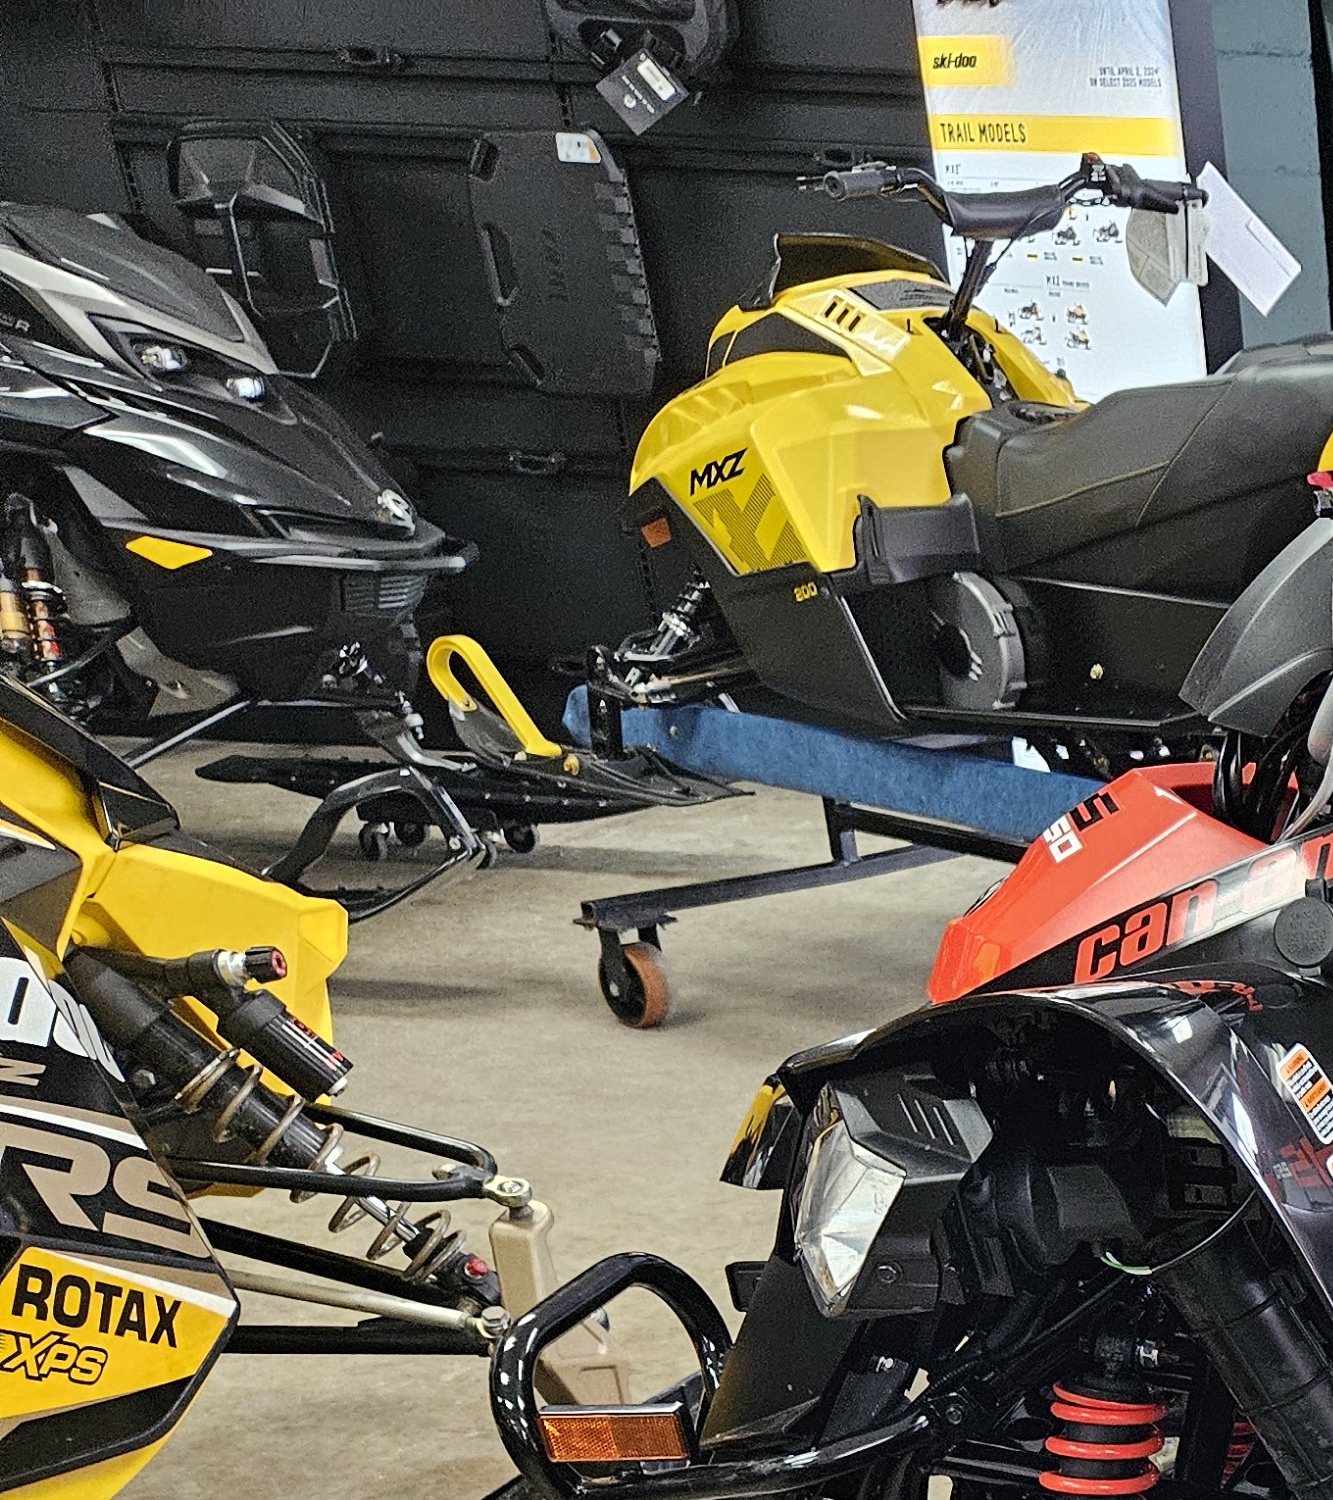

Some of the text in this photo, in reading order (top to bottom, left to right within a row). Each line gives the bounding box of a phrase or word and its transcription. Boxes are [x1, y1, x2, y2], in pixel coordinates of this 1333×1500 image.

[933, 54, 977, 69] ski-doo
[940, 123, 1026, 143] TRAIL MODELS
[690, 448, 749, 497] MXZ
[12, 1264, 183, 1349] ROTAX
[4, 1332, 108, 1385] XPS
